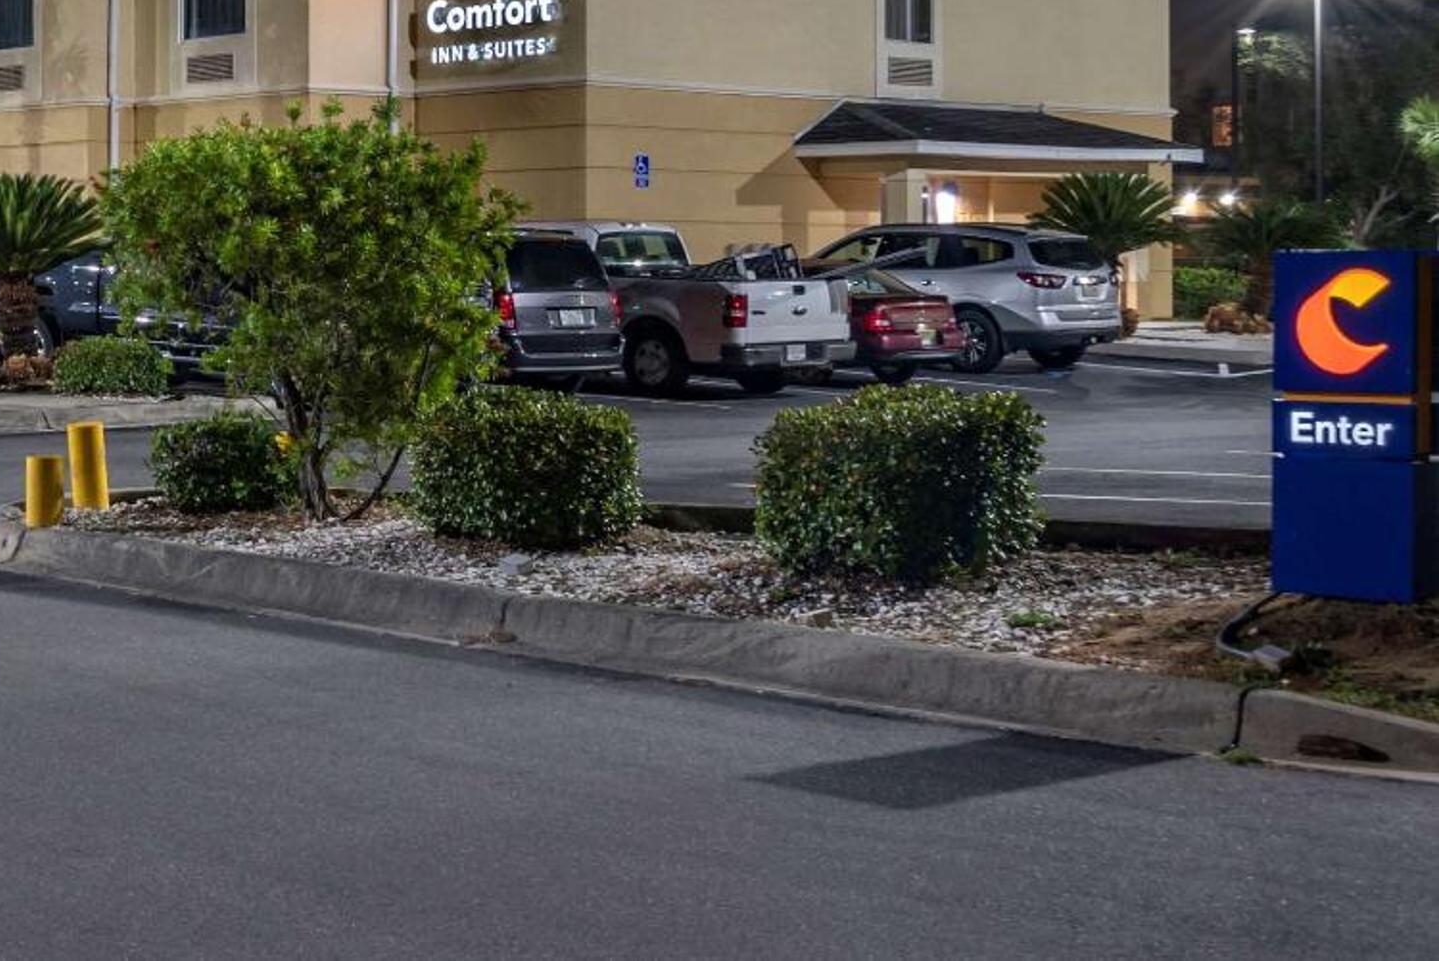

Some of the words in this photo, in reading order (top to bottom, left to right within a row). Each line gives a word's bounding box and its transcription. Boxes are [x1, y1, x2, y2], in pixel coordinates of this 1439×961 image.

[431, 45, 463, 65] INN
[467, 43, 479, 61] &
[483, 37, 547, 60] SUITES
[1290, 411, 1393, 446] Enter
